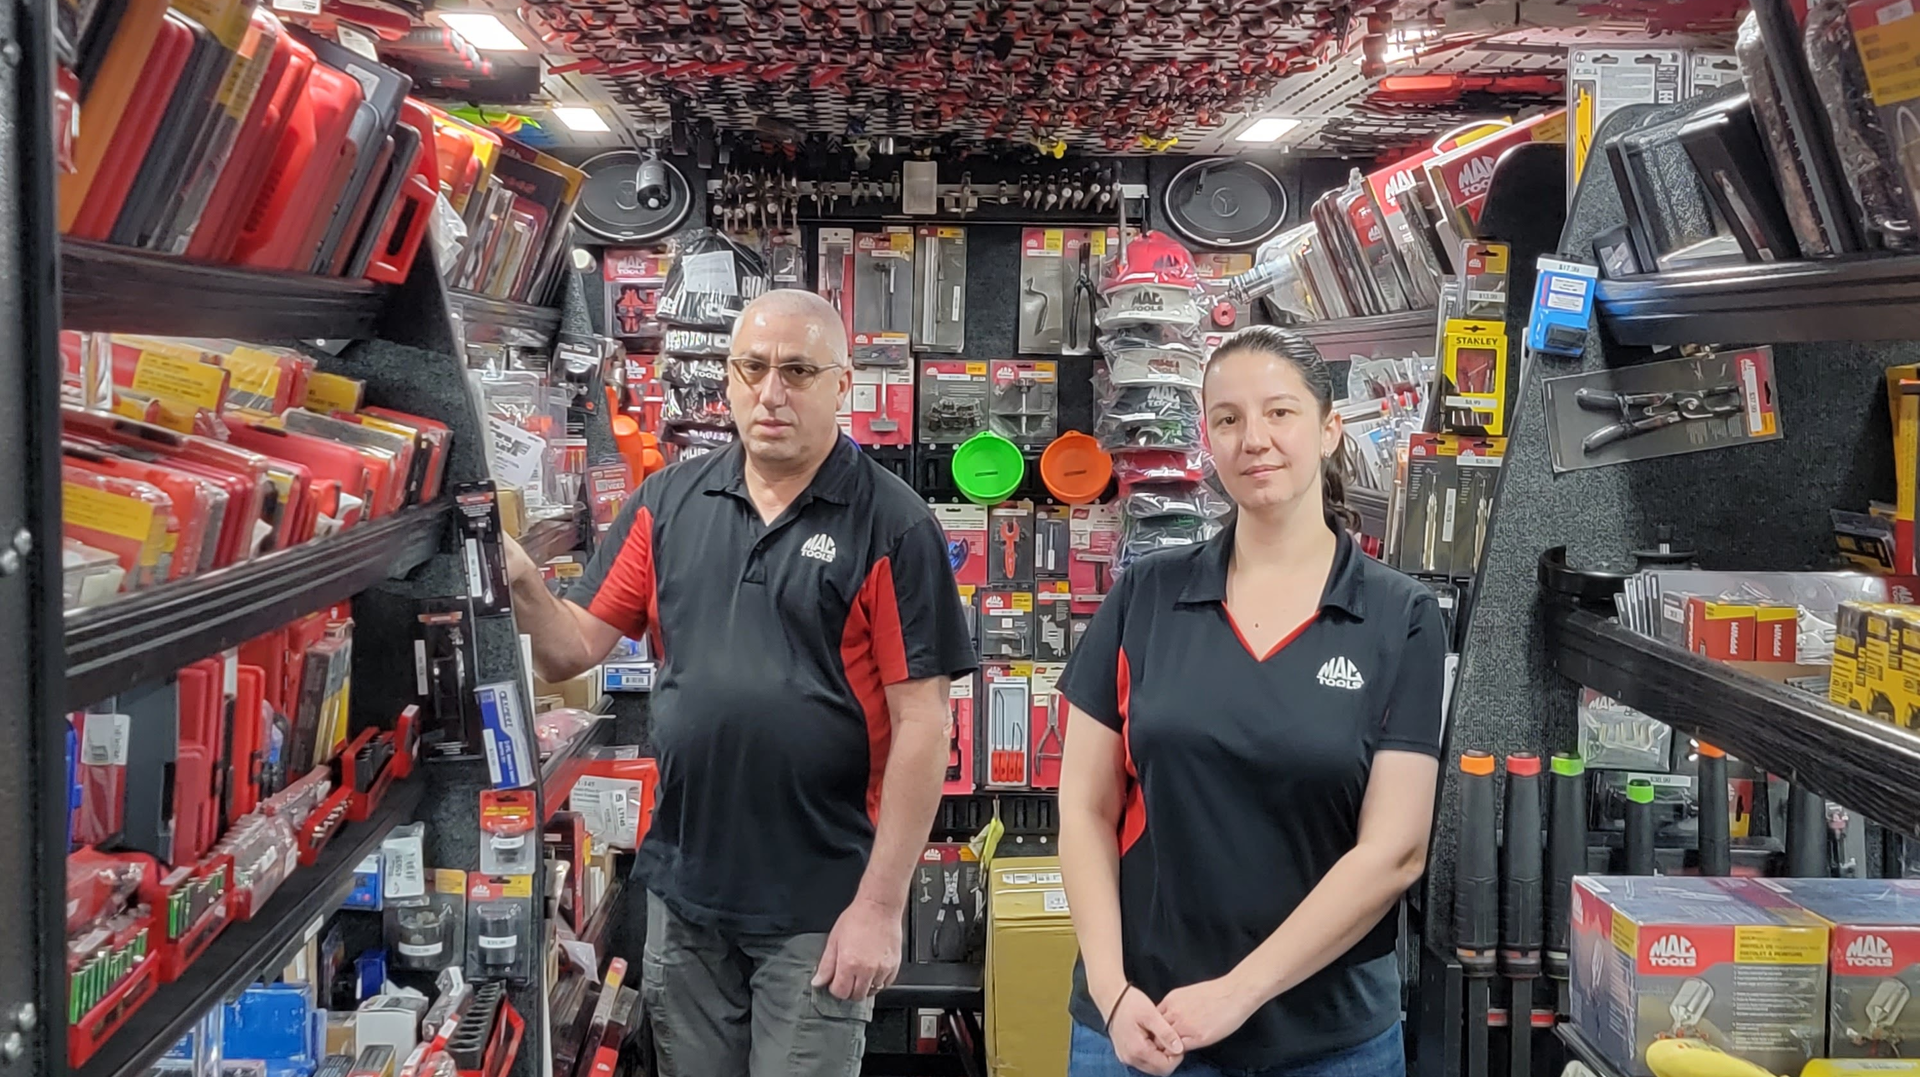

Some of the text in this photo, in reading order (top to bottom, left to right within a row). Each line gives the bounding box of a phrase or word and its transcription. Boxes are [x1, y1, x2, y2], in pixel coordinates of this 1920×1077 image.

[1460, 181, 1489, 197] TOO
[1132, 291, 1164, 305] MAC
[1456, 336, 1498, 347] STANLEY
[801, 533, 836, 557] MAC
[801, 549, 835, 563] TOOLS
[1316, 656, 1364, 684] MAC
[1316, 676, 1363, 690] TOOLS
[1650, 934, 1697, 958] MAC
[1846, 934, 1894, 958] MAC
[1650, 957, 1697, 967] TOOLS
[1846, 957, 1893, 967] TOOLS
